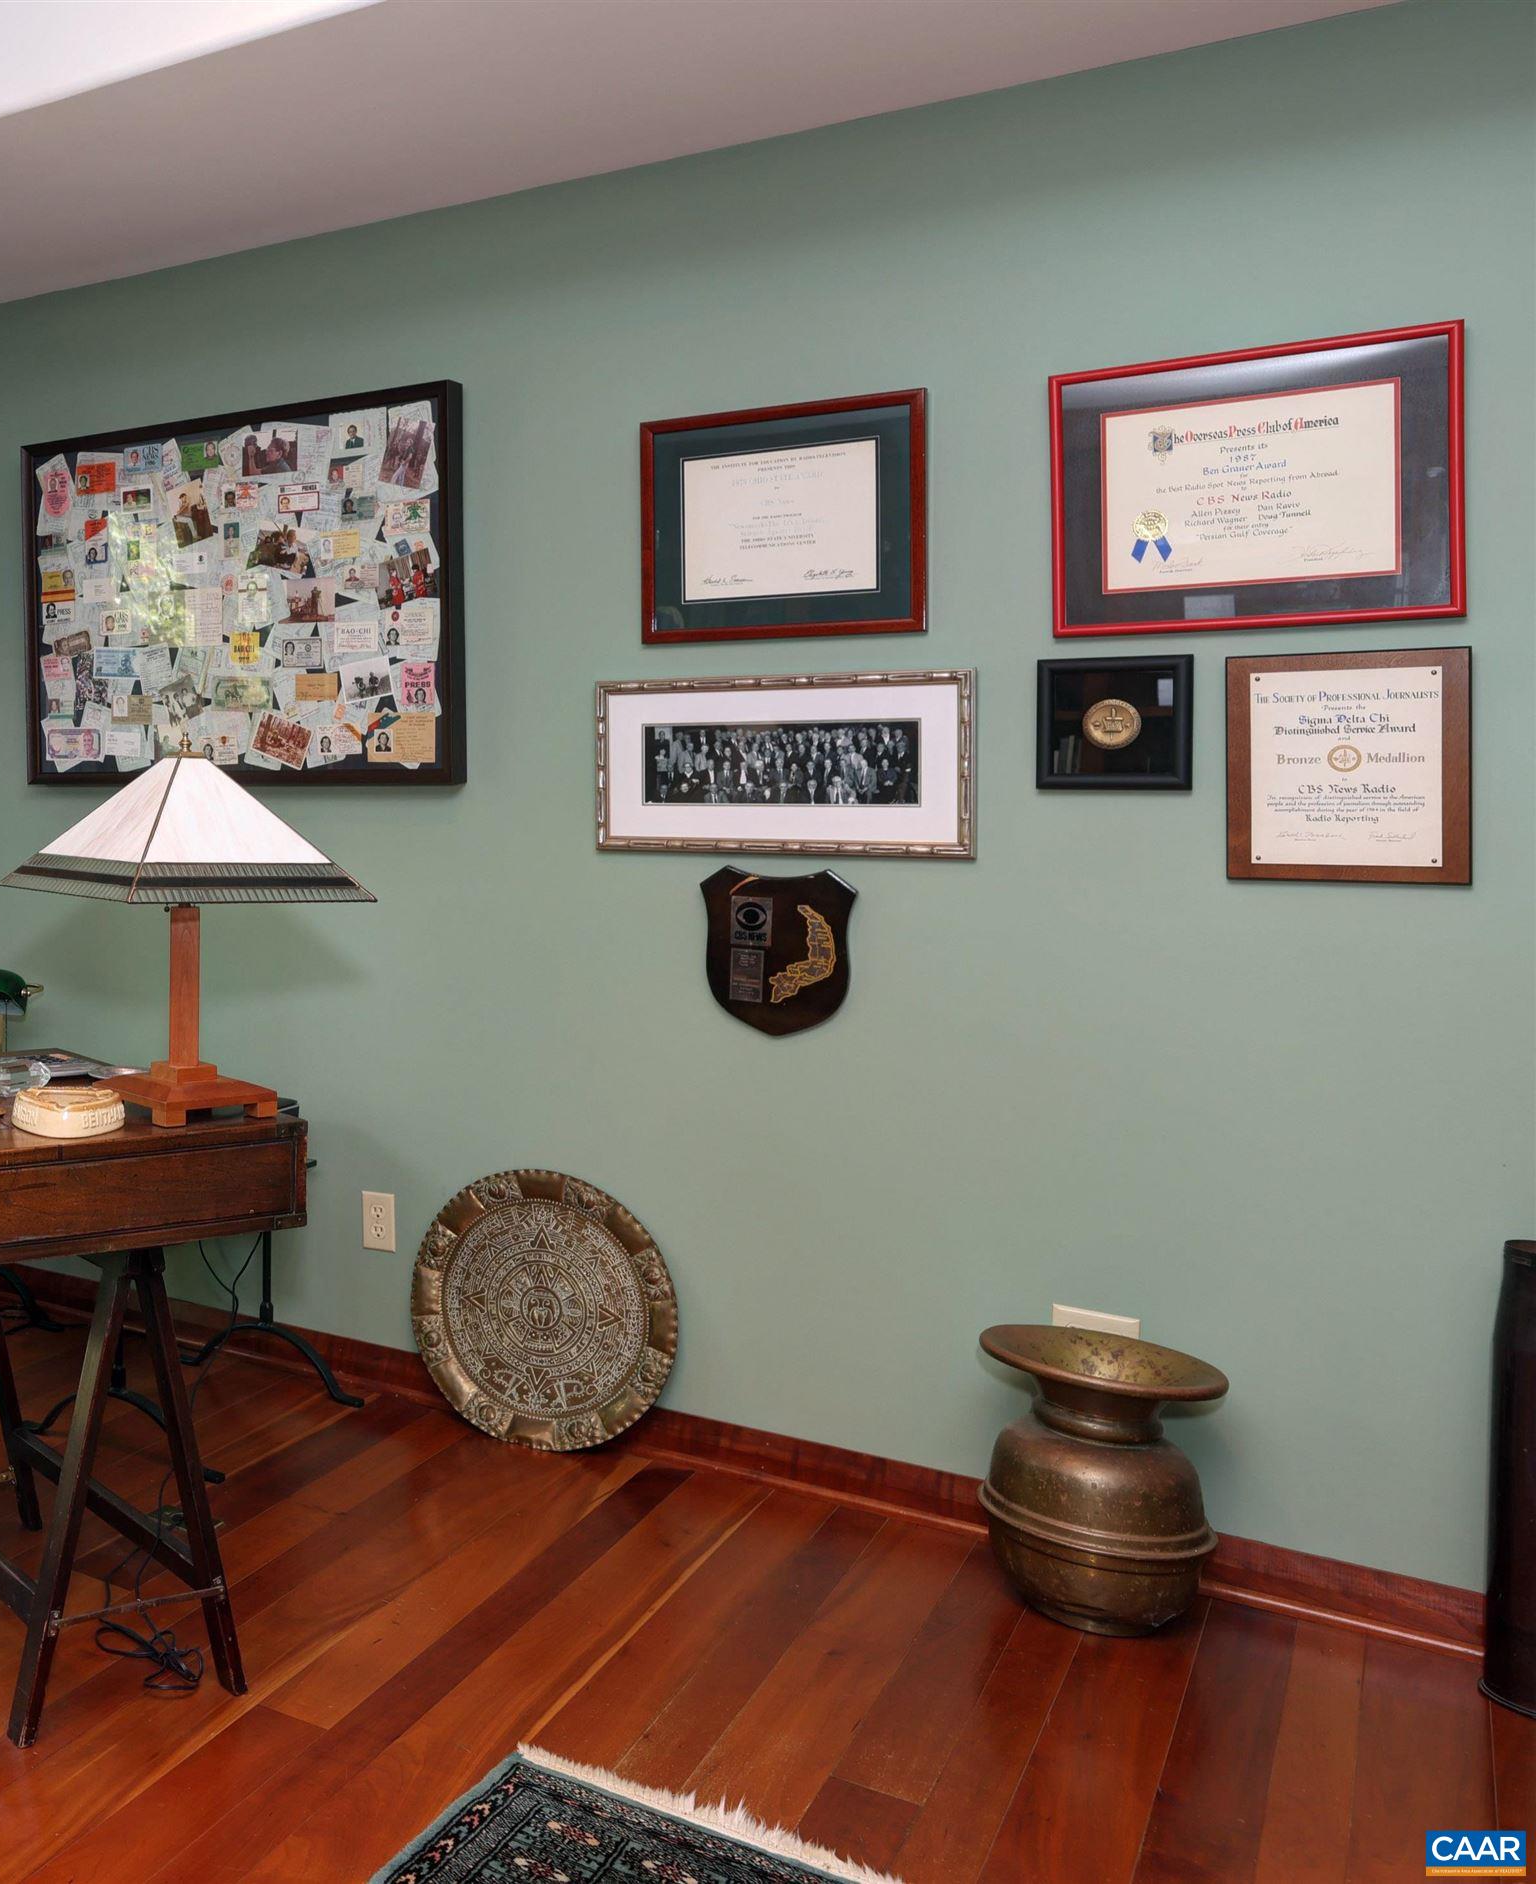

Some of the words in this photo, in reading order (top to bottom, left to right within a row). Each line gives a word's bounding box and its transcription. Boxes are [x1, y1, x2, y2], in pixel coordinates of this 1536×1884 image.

[1185, 429, 1228, 443] Overseas
[1228, 425, 1256, 438] Press
[1257, 420, 1281, 434] Club
[1282, 418, 1293, 431] of
[1294, 415, 1339, 430] America
[1220, 444, 1254, 454] Presents
[1230, 454, 1257, 463] 1987
[1202, 466, 1219, 476] Ben
[1222, 464, 1254, 474] Grauer
[1256, 459, 1287, 471] Award
[1196, 494, 1225, 506] CBS
[1231, 493, 1258, 503] News
[1261, 490, 1292, 500] Radio
[1191, 509, 1212, 518] Allen
[1184, 518, 1215, 528] Richard
[1254, 693, 1269, 704] THE
[1298, 714, 1332, 727] Sigma
[1335, 713, 1366, 724] Delta
[1369, 712, 1390, 723] Chi
[1276, 753, 1322, 765] Bronze
[1366, 751, 1425, 764] Medallion
[1298, 784, 1324, 794] CBS
[1327, 784, 1358, 794] News
[1361, 783, 1397, 794] Radio
[1305, 813, 1332, 822] Radio
[1334, 813, 1379, 824] Reporting
